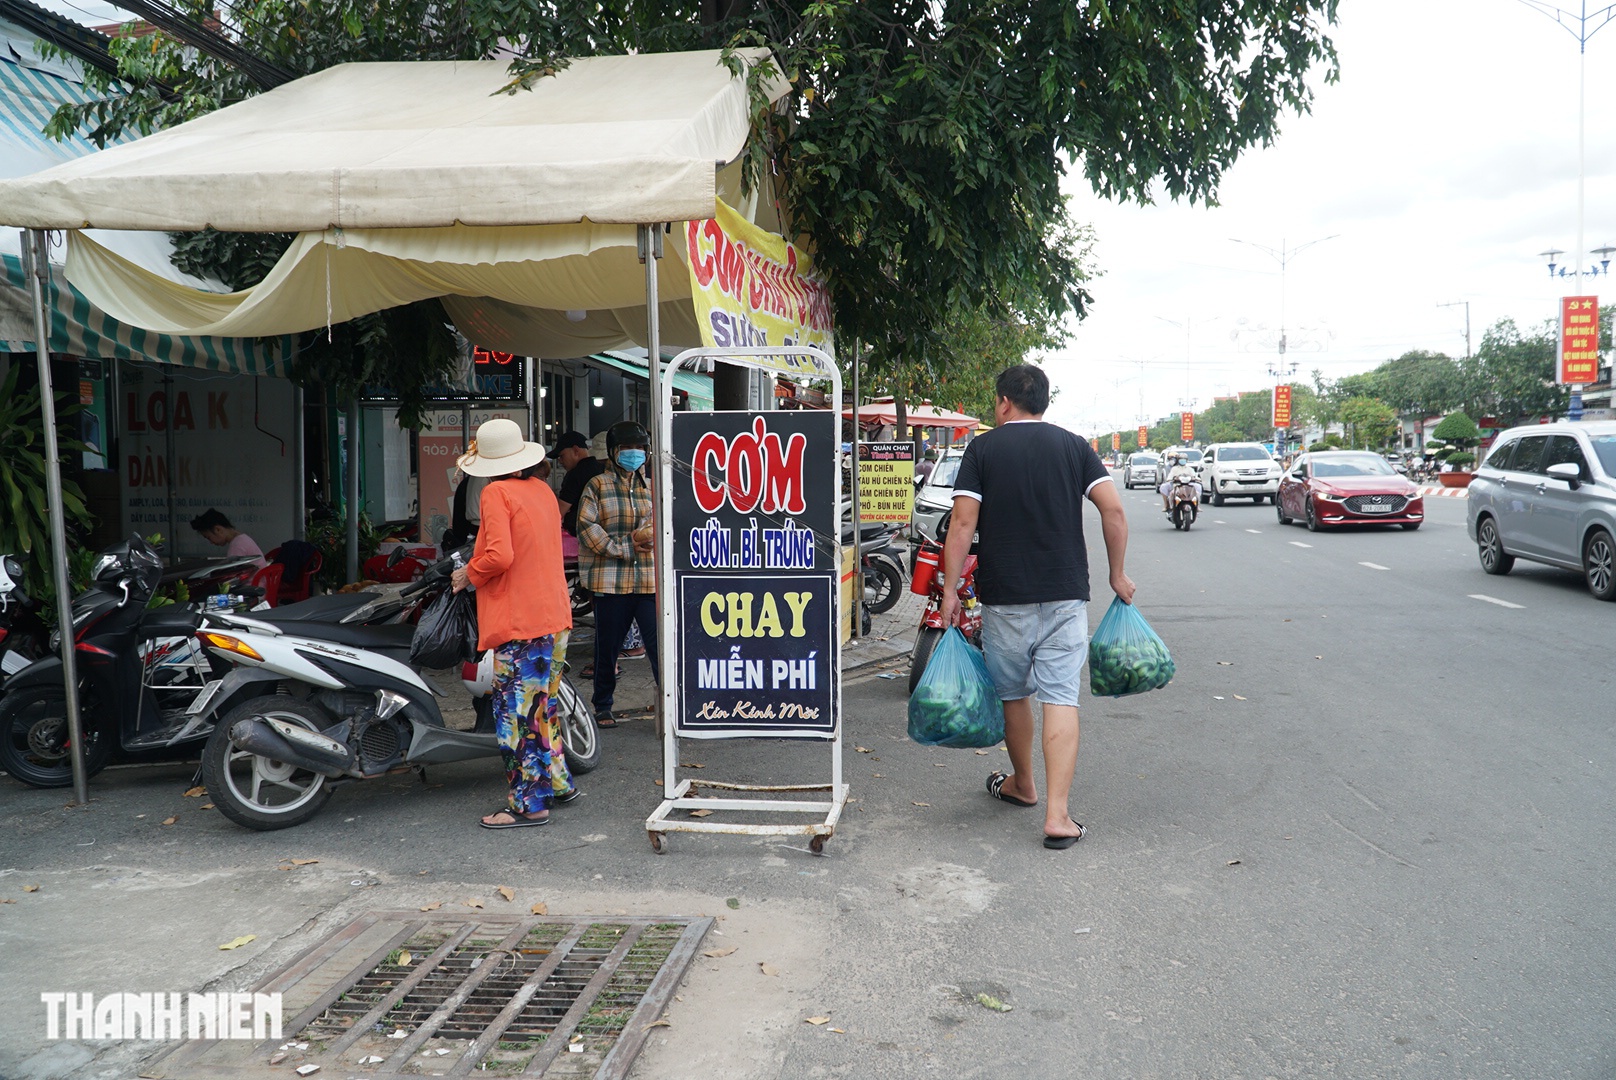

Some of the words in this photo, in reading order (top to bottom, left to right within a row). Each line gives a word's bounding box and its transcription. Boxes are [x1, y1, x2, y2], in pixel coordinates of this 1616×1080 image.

[691, 415, 807, 514] CƠM
[872, 444, 891, 452] QUÁN
[763, 518, 815, 569] TRỨNG
[700, 591, 813, 638] CHAY
[697, 645, 764, 690] MIỄN
[771, 651, 817, 690] PHÍ
